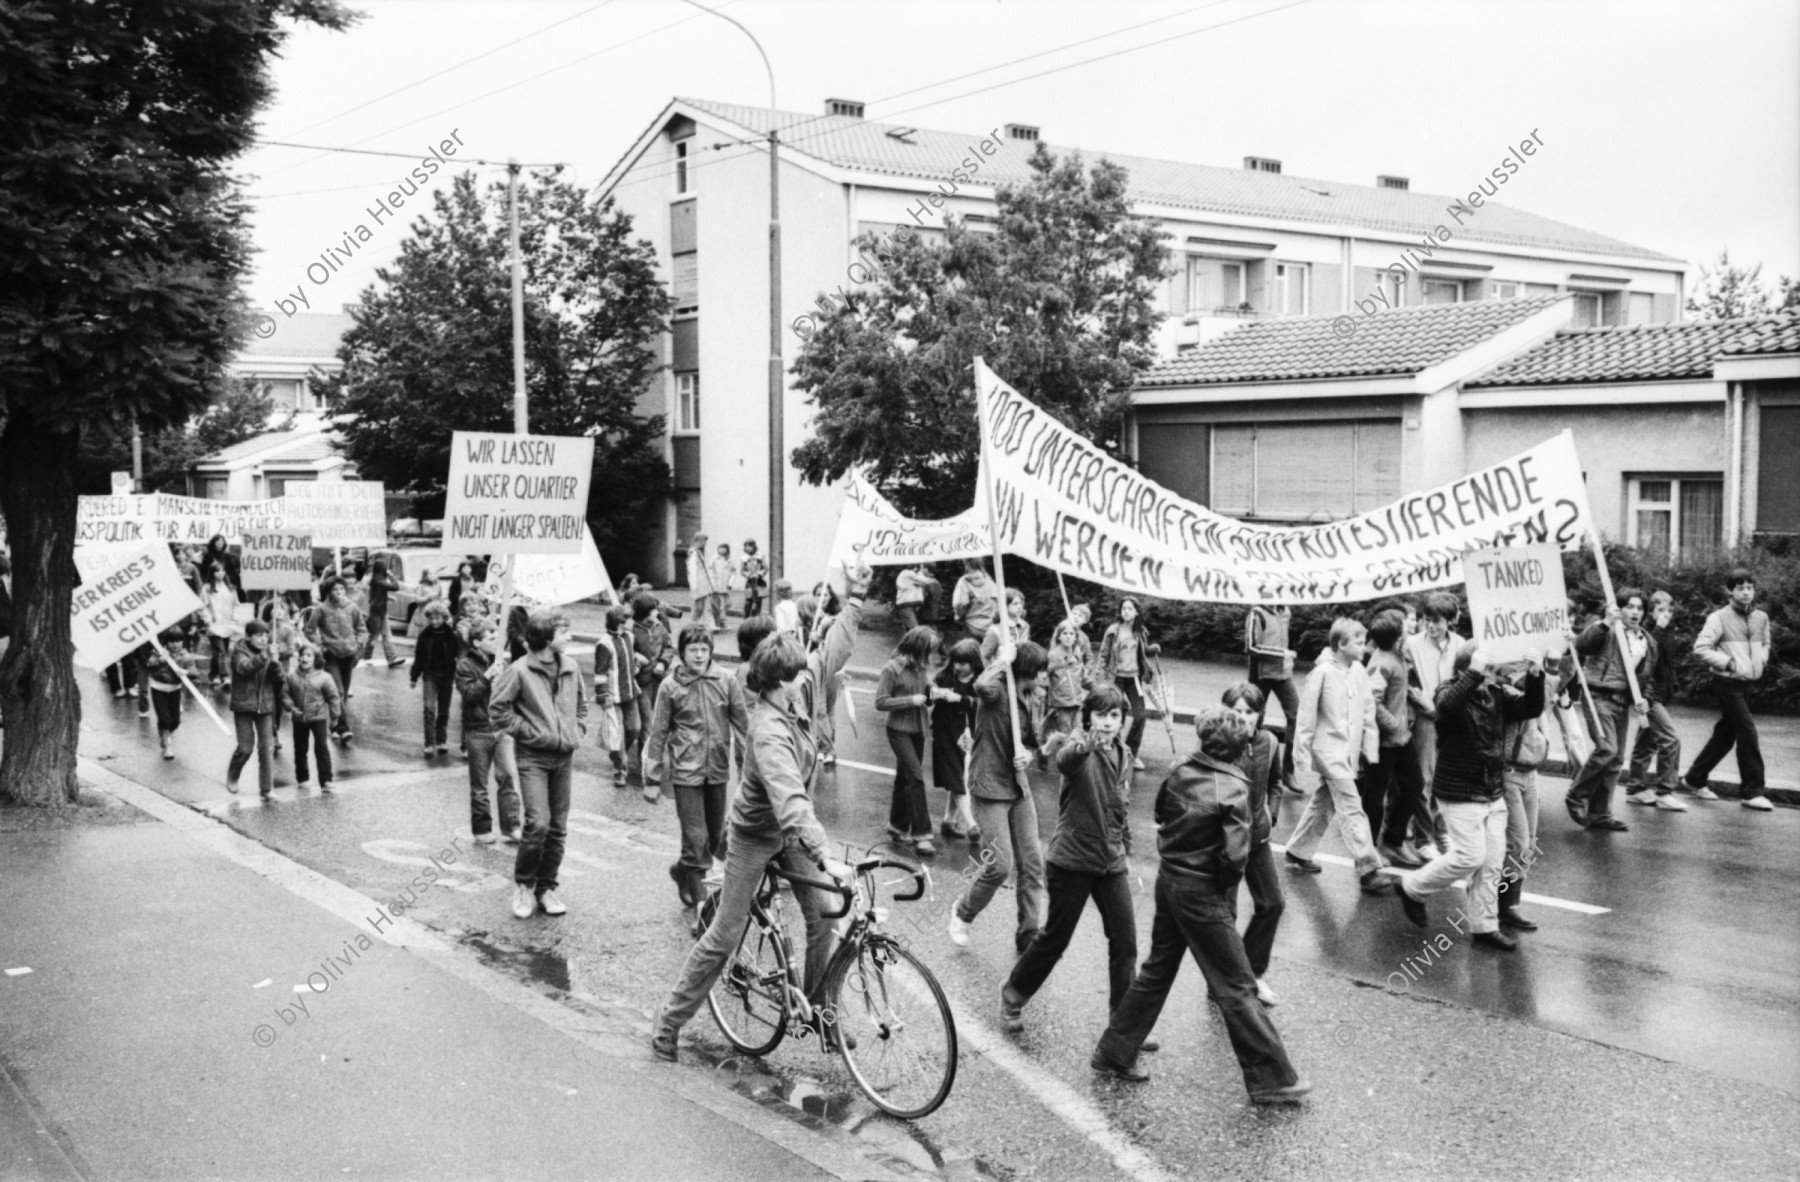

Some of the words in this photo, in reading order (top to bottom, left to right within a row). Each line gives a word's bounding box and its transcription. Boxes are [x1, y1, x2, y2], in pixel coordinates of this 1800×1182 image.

[467, 439, 495, 464] WIR
[501, 440, 555, 466] LASSEN
[464, 474, 510, 499] UNSER
[514, 474, 578, 500] QUARTIER
[452, 514, 489, 539] NICHT
[491, 509, 536, 540] LÄNGER
[537, 514, 585, 540] SPALTEN!
[243, 533, 283, 550] PLATZ
[70, 589, 100, 617] DER
[96, 562, 143, 597] KREIS
[140, 554, 156, 570] 3
[1478, 551, 1544, 590] TÄNKED
[89, 608, 116, 633] IST
[113, 581, 161, 617] KEINE
[118, 609, 160, 643] CITY
